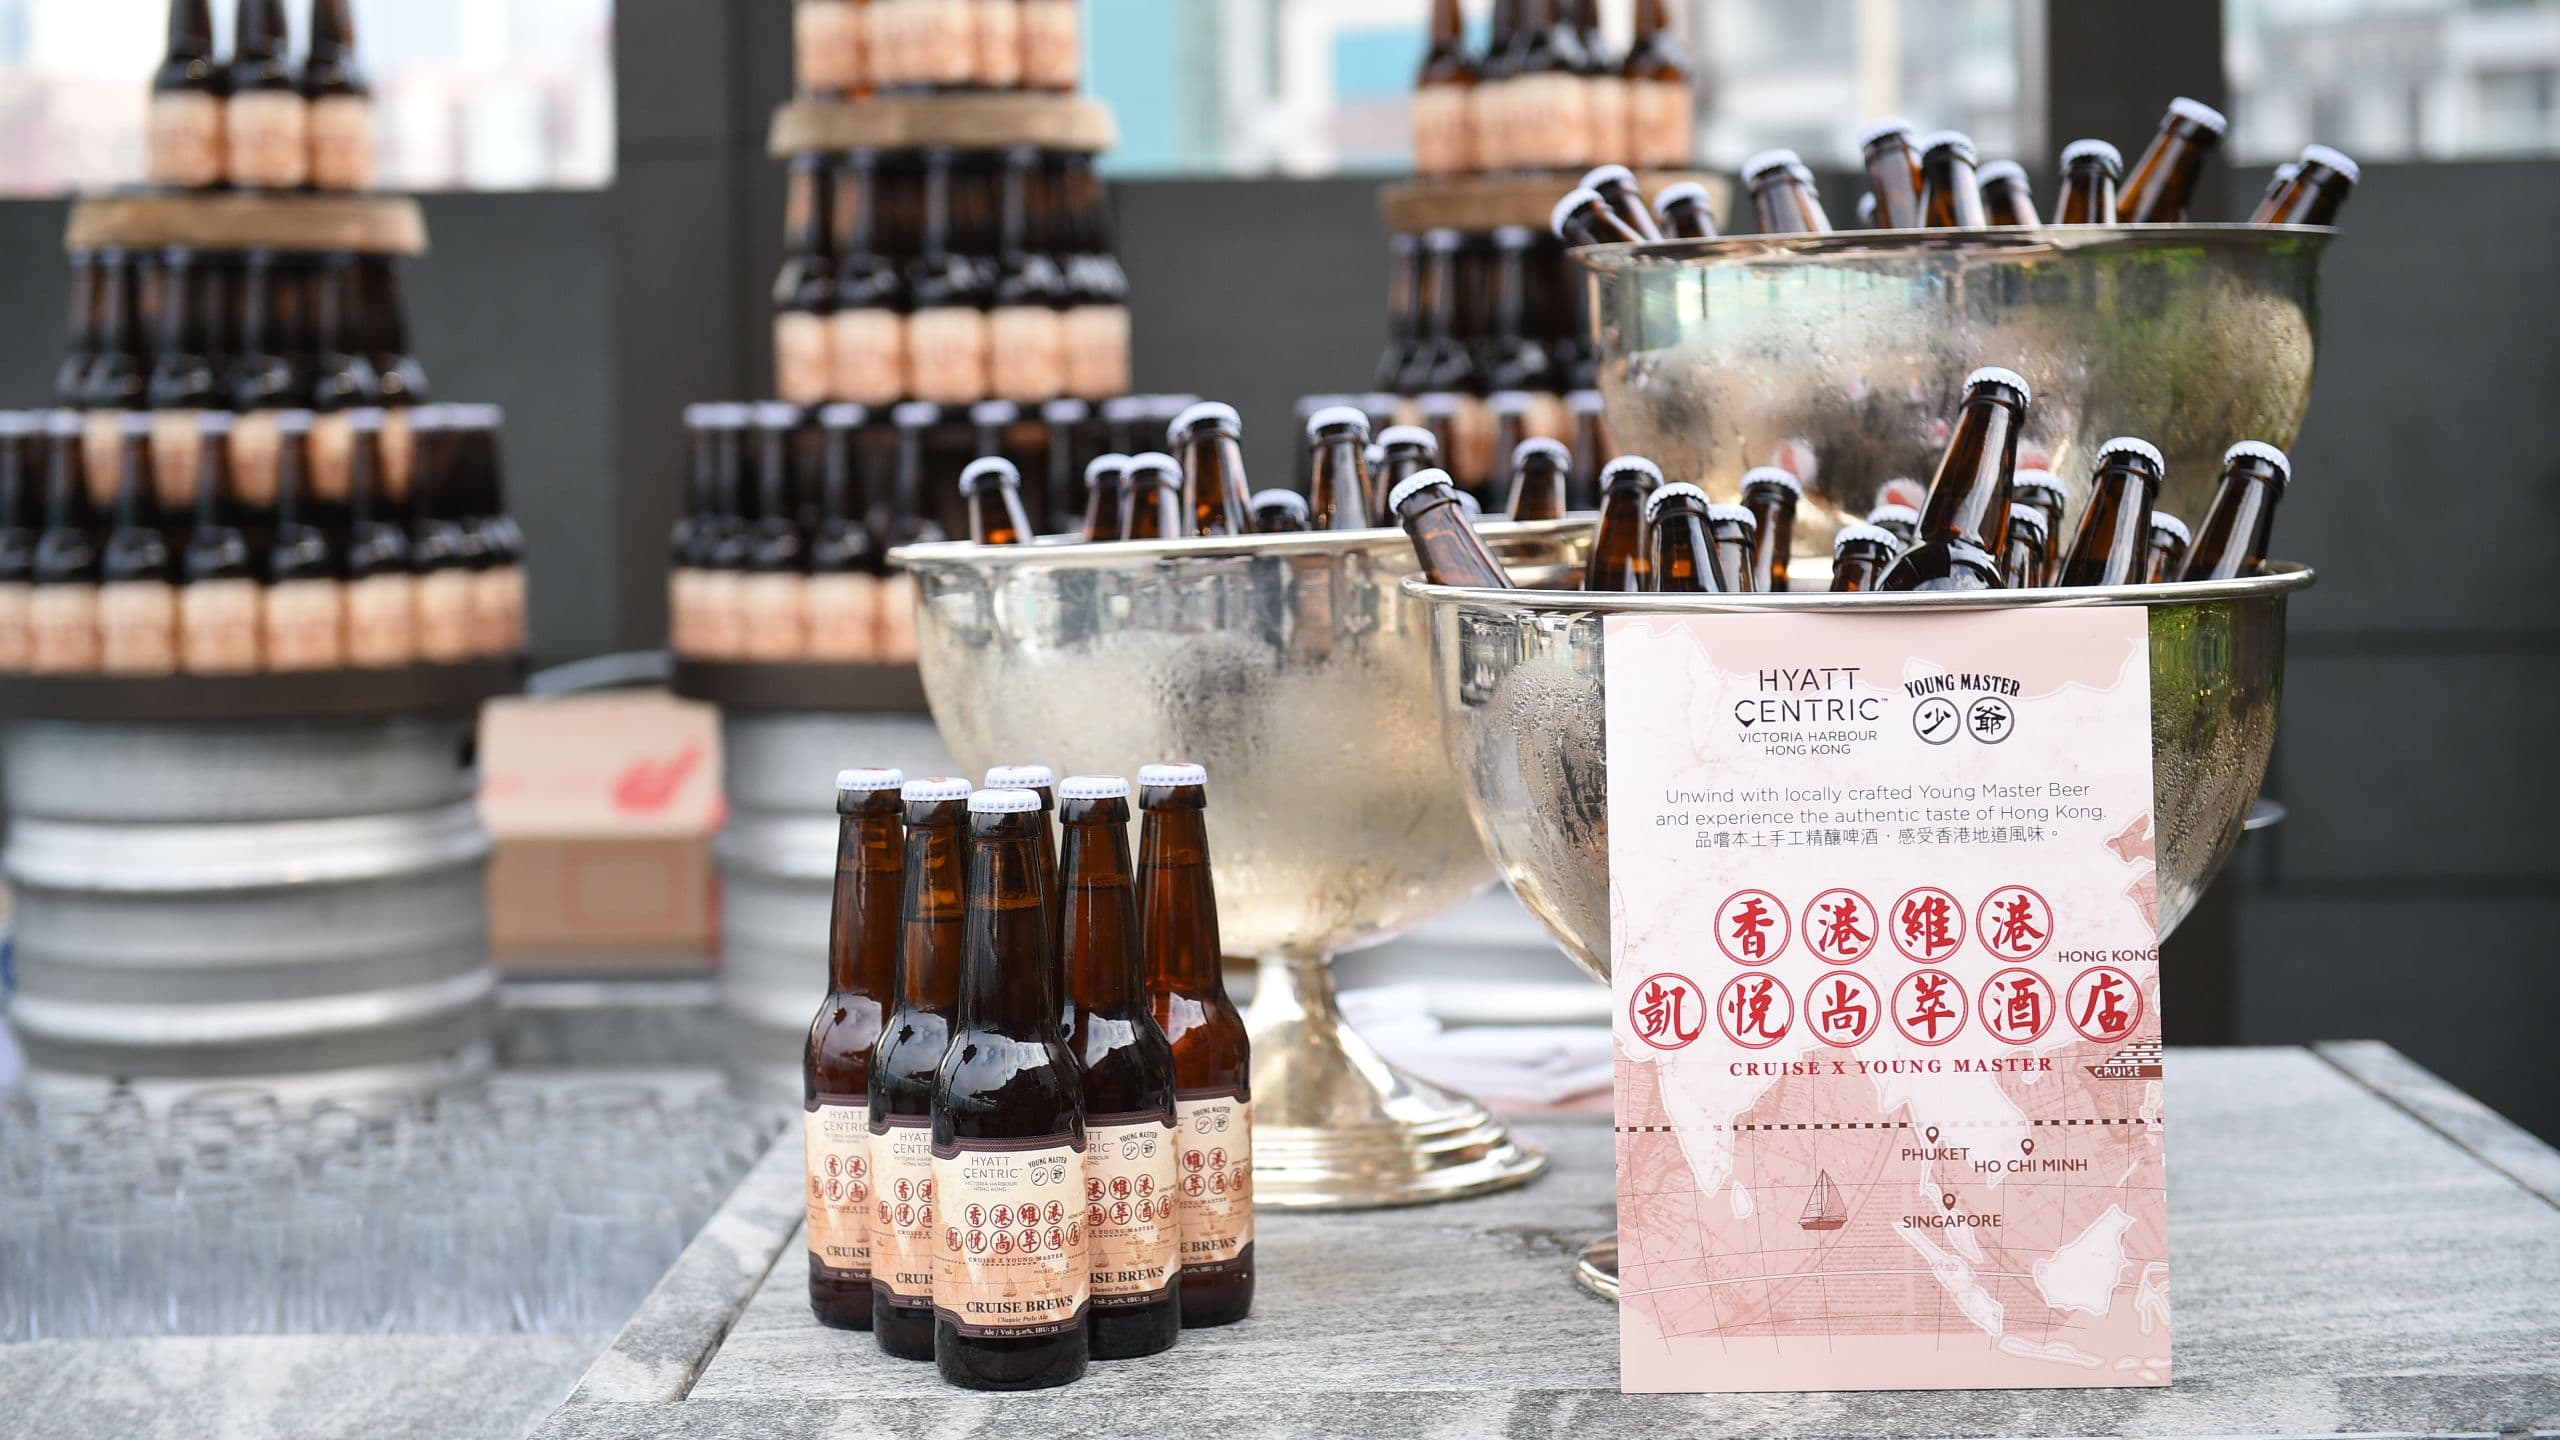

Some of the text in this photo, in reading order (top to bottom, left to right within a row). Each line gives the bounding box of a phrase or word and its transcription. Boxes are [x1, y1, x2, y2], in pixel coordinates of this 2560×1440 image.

[1759, 667, 1860, 692] HYATT
[1904, 673, 2021, 698] YOUNG MASTER
[1919, 702, 2010, 738] 少爺
[1738, 730, 1878, 743] VICTORIA HARBOUR
[1765, 743, 1851, 756] HONG KONG
[1665, 782, 2091, 804] Unwind with locally crafted Young Master Beer
[1655, 804, 2107, 828] and experience the authentic taste of Hong Kong.
[1730, 894, 2045, 959] 香港維港
[2058, 948, 2159, 963] HONG KONG
[1638, 973, 2129, 1042] 凱悅尚萃酒店
[1729, 1057, 2053, 1077] CRUISE X YOUNG MASTER
[2093, 1066, 2141, 1078] CRUISE
[829, 1111, 864, 1120] HYATT
[971, 1156, 1011, 1167] HYATT
[1028, 1156, 1068, 1168] YOUNG MASTER
[1901, 1147, 1970, 1161] PHUKET
[1974, 1158, 2088, 1173] HO CHI MINH
[968, 1202, 1062, 1226] 香港維港
[1902, 1214, 2002, 1229] SINGAPORE
[1191, 1236, 1237, 1253] BREWS
[968, 1256, 996, 1264] CRUISE
[1035, 1253, 1063, 1261] MASTER
[1117, 1266, 1165, 1283] BREWS
[966, 1295, 1073, 1314] CRUISE BREWS
